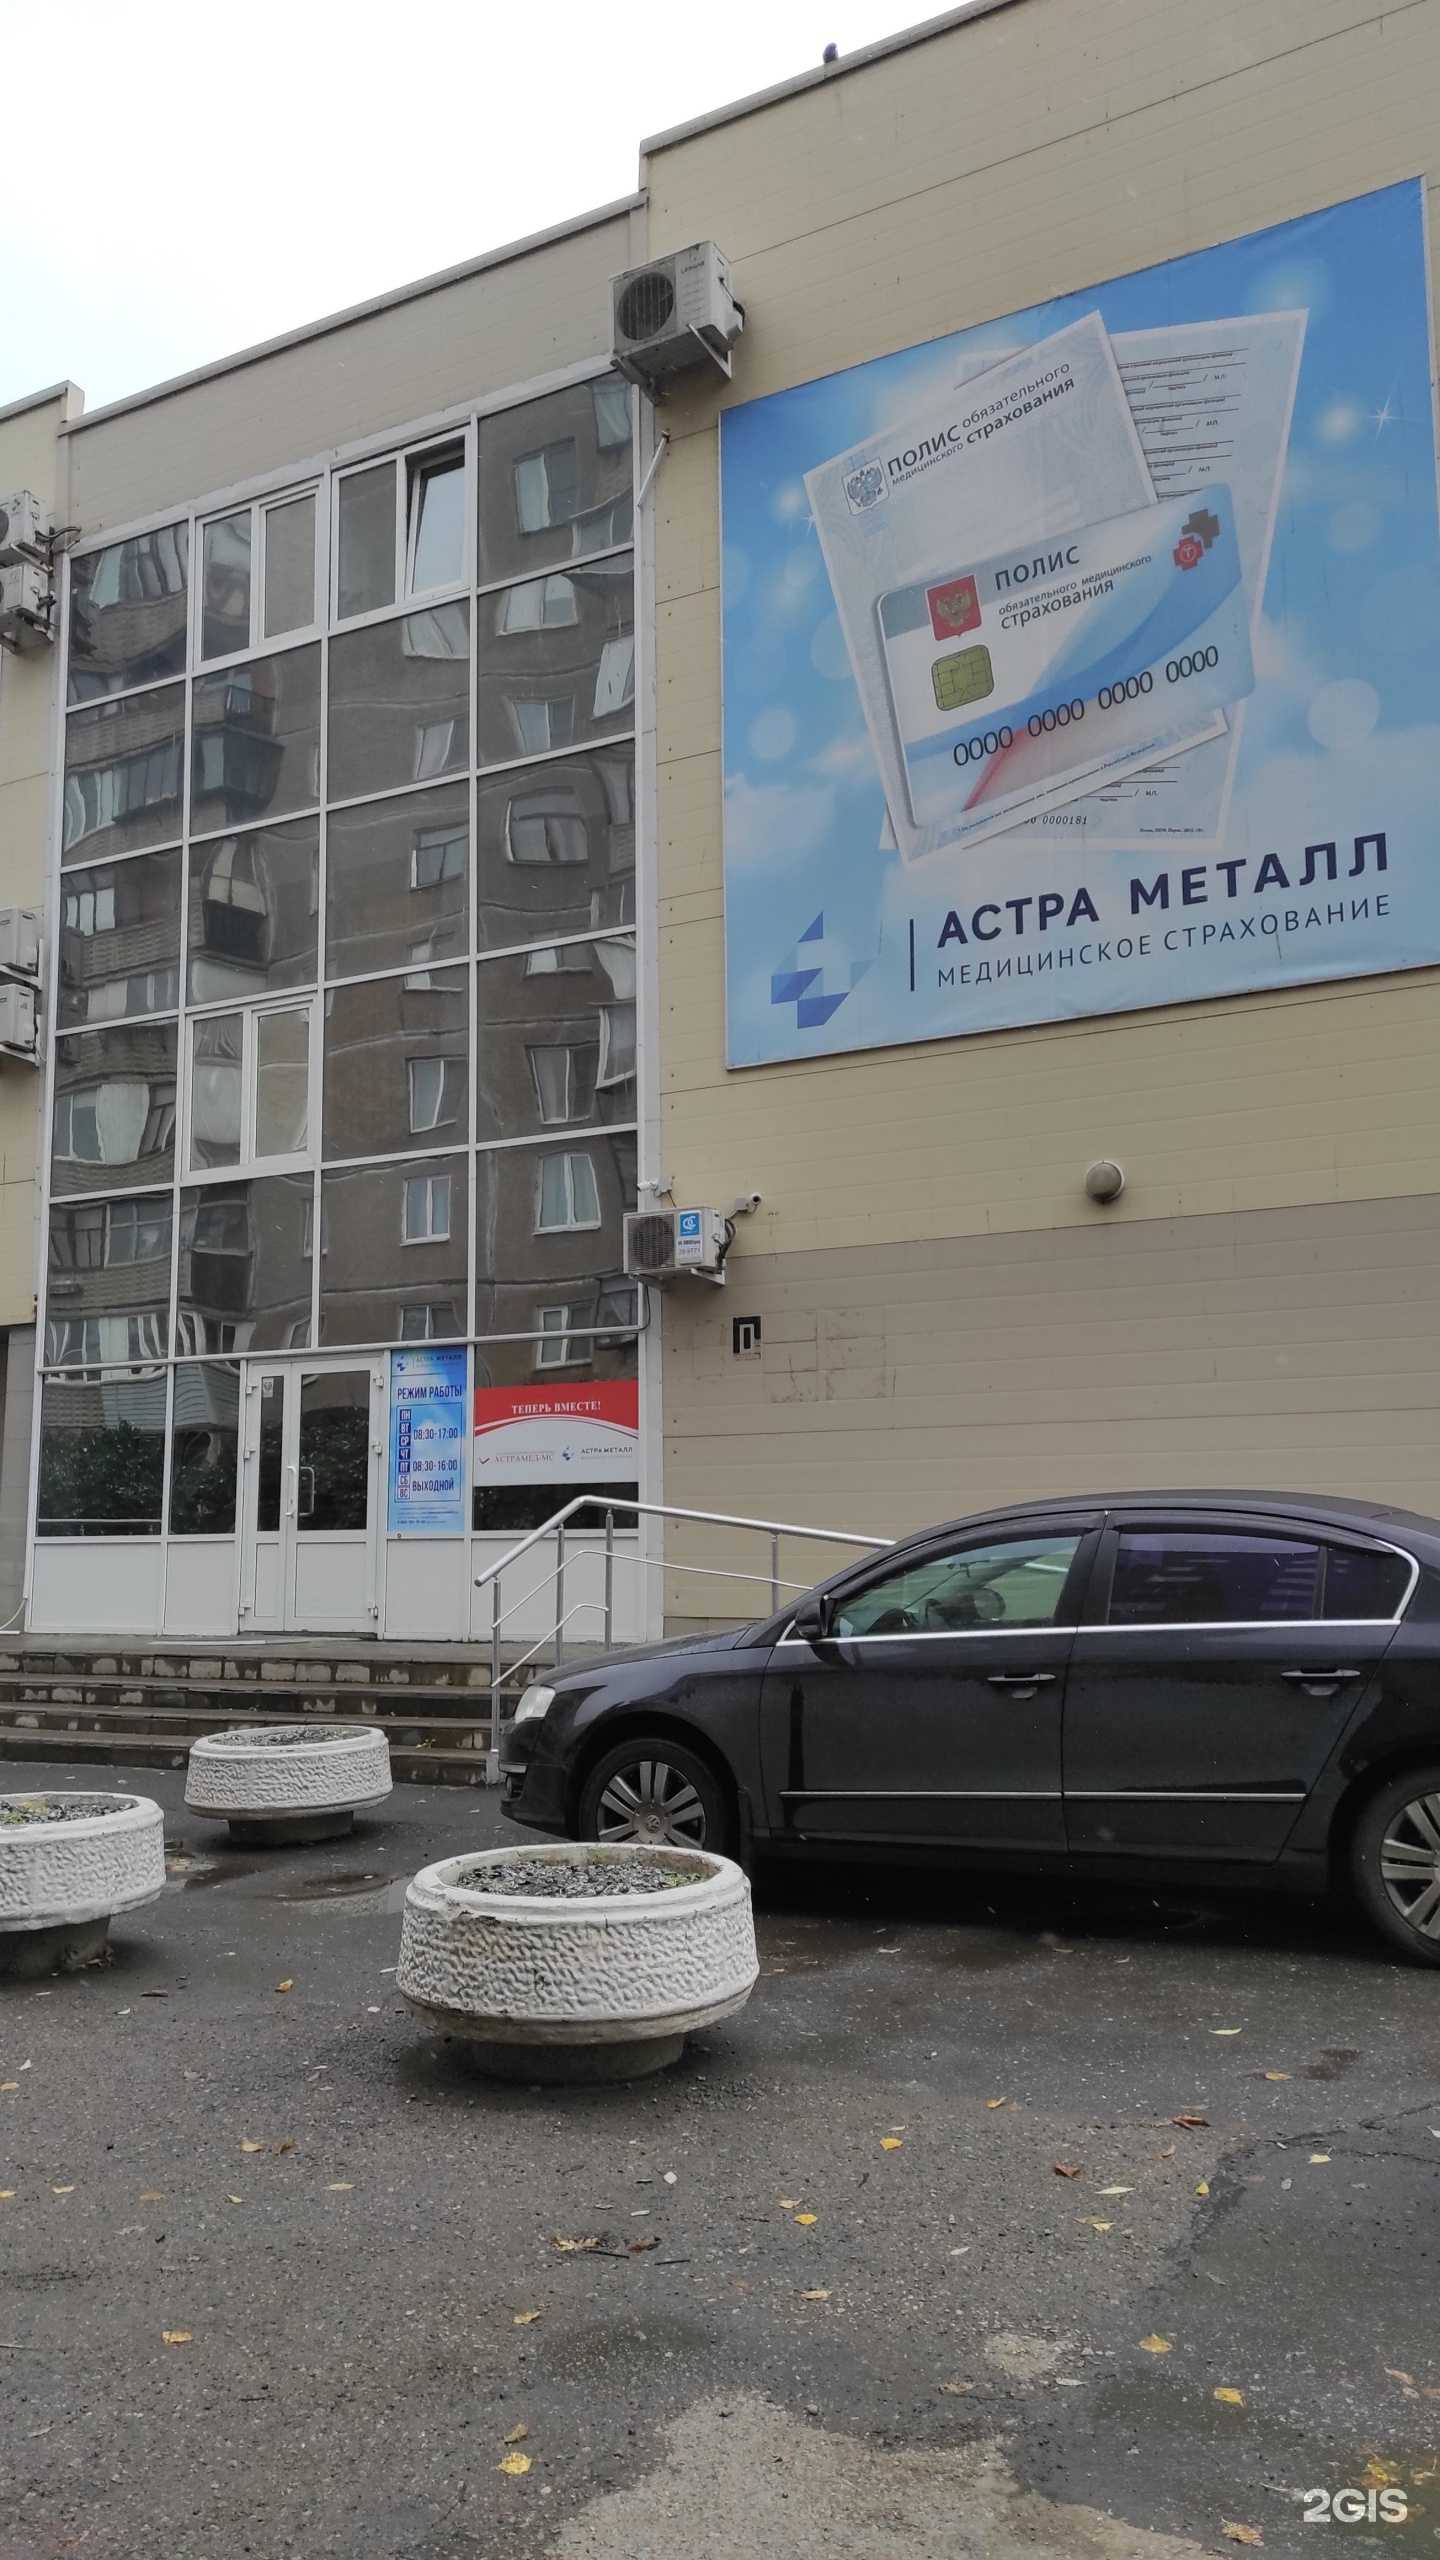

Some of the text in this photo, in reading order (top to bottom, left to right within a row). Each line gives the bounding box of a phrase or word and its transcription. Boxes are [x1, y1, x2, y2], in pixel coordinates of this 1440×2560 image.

[887, 363, 1070, 476] ПОЛИС обязательного
[892, 378, 1075, 487] медицинского страхования
[995, 545, 1080, 591] ПОЛИС
[998, 555, 1152, 616] обязательного медицинского
[1001, 579, 1115, 630] страхования
[953, 645, 1219, 766] 0000 0000 0000 0000
[1042, 815, 1088, 825] 0000181
[937, 832, 1388, 948] АСТРА МЕТАЛЛ
[938, 894, 1390, 988] МЕДИЦИНСКОЕ СТРАХОВАНИЕ
[397, 1384, 462, 1400] РЕЖИМ РАБОТЫ
[401, 1410, 411, 1420] ПН
[512, 1401, 601, 1415] ТЕПЕРЬ ВМЕСТЕ!
[400, 1423, 410, 1433] ВТ
[400, 1436, 410, 1446] СР
[400, 1449, 409, 1459] ЧТ
[400, 1462, 409, 1472] ПТ
[412, 1478, 455, 1492] ВЫХОДНОЙ
